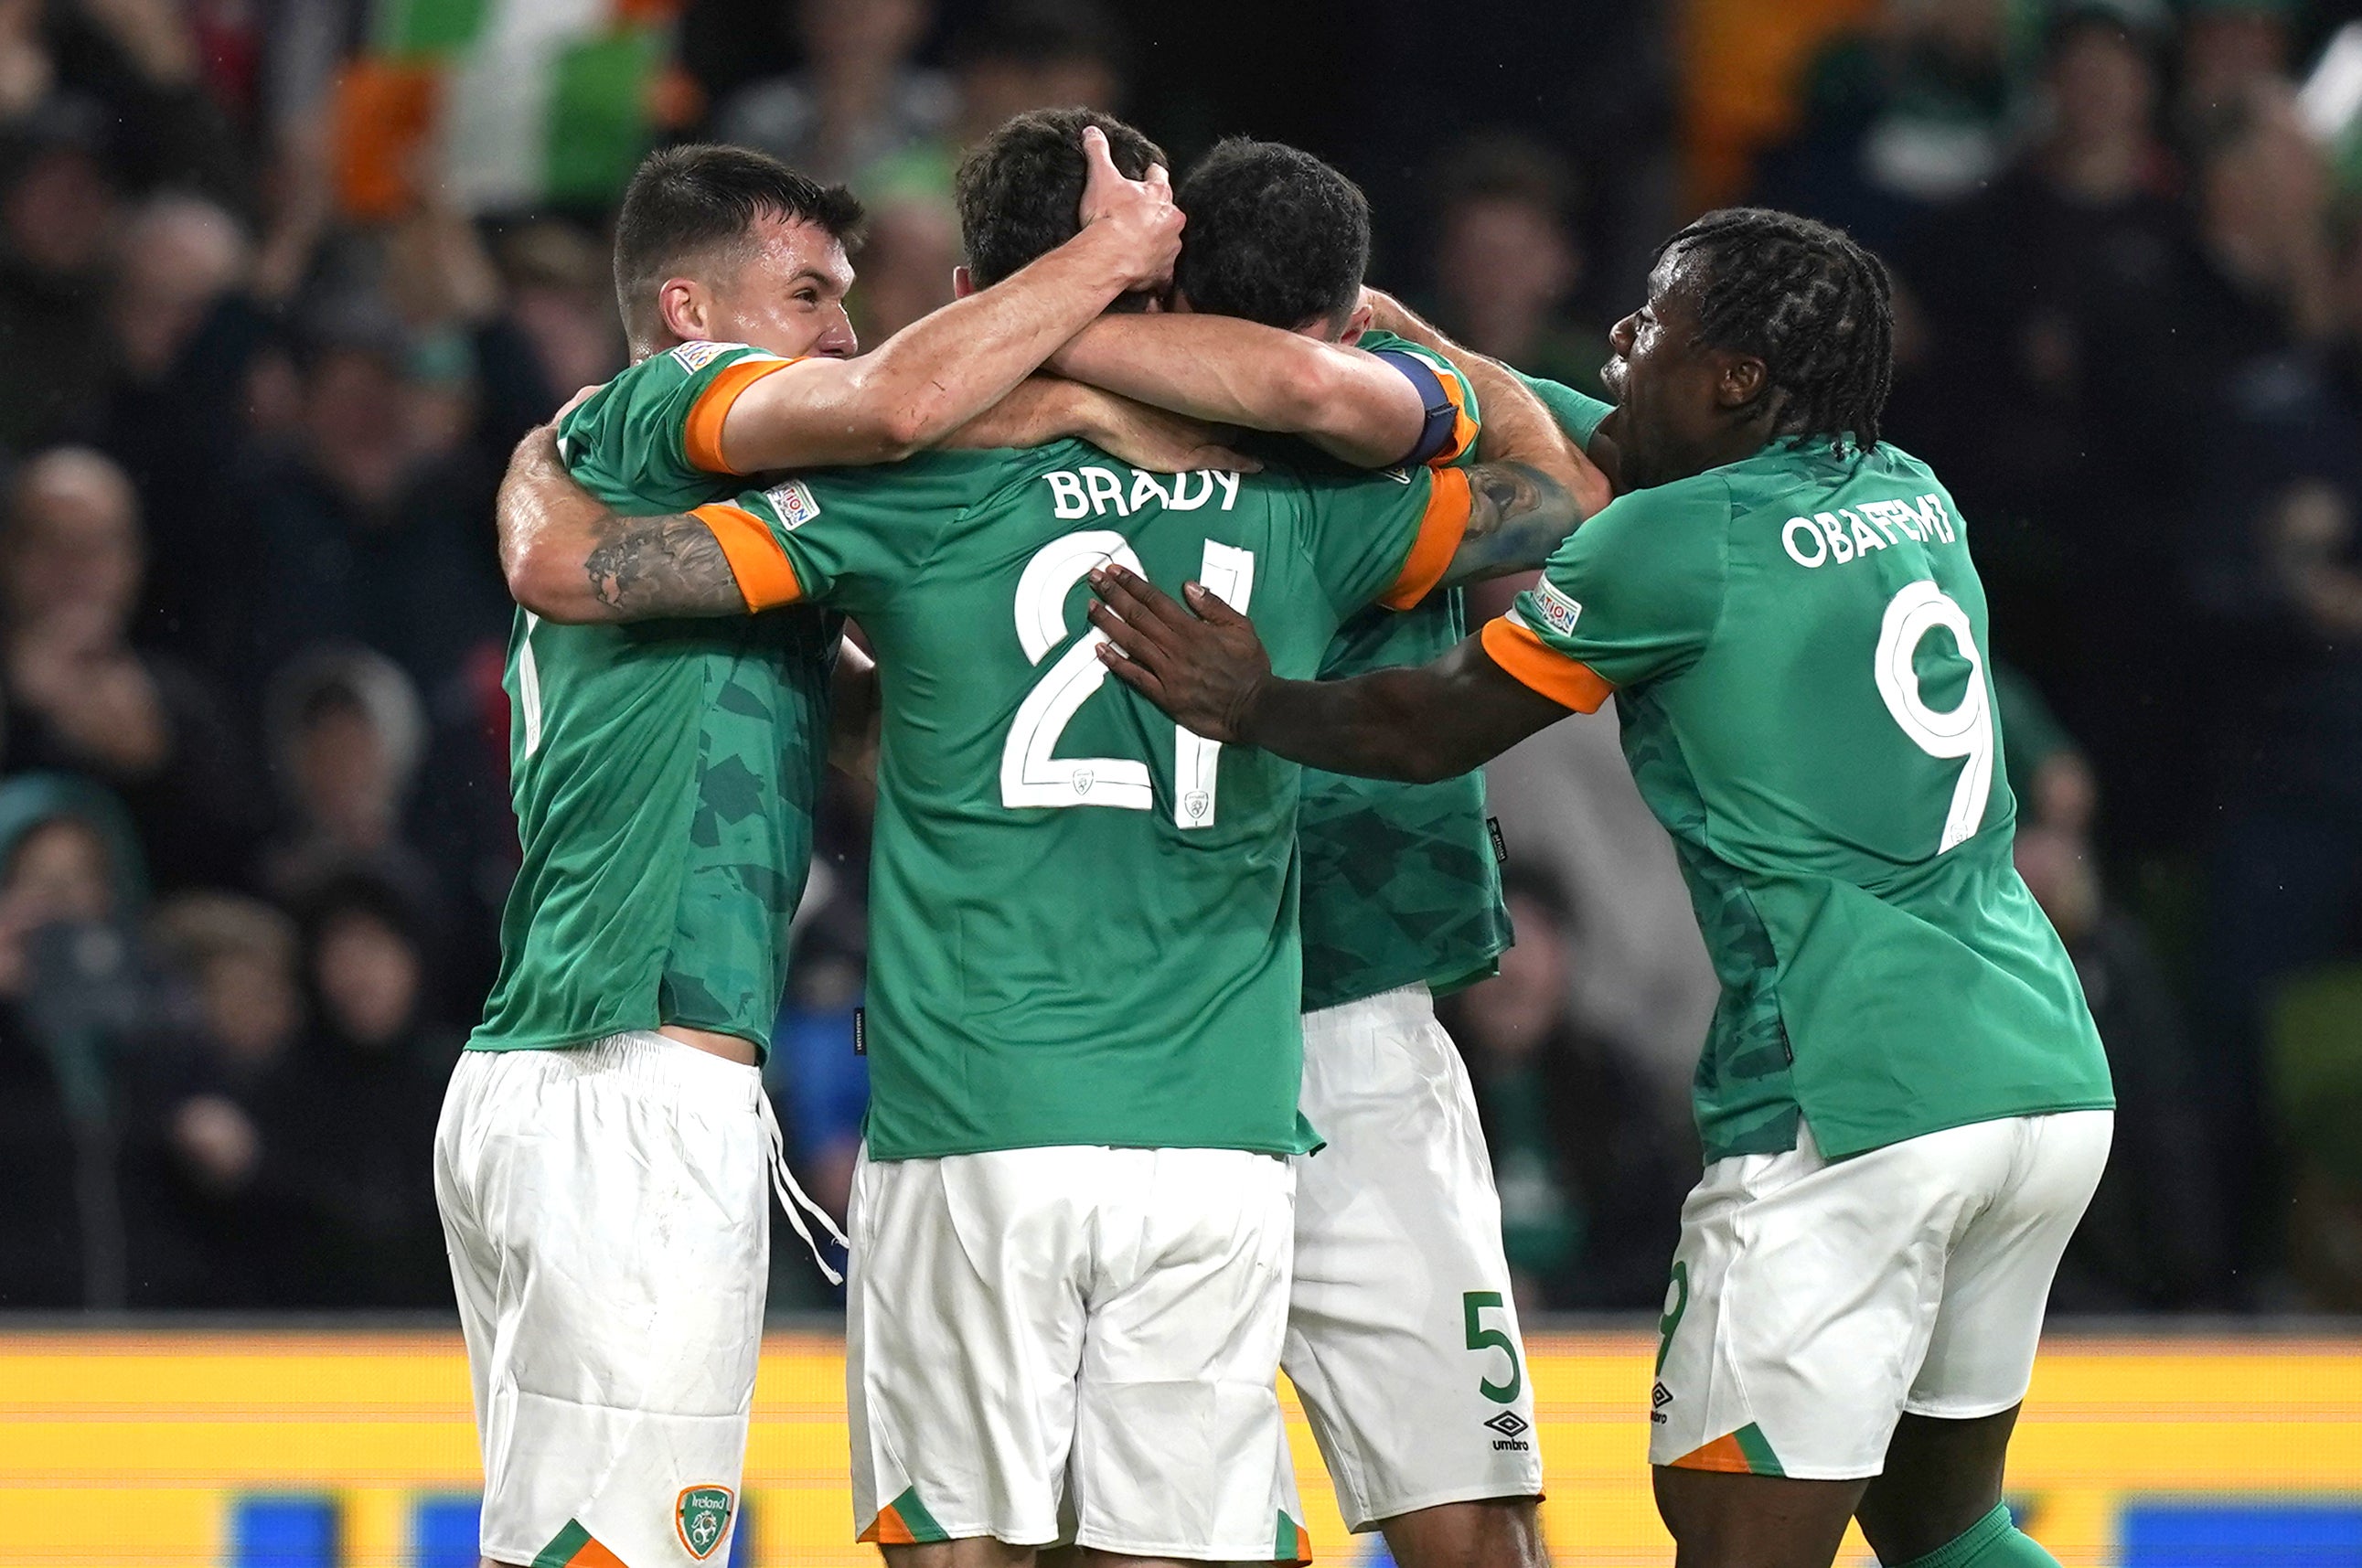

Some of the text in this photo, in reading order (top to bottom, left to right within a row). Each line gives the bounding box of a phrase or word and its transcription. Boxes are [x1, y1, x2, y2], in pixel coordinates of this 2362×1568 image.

[1042, 466, 1241, 520] BRADY
[1780, 493, 1956, 569] OBAFEMI
[1538, 592, 1576, 626] ATION
[1000, 529, 1255, 830] 21
[1875, 580, 1993, 856] 9
[1463, 1291, 1521, 1404] 5
[1492, 1438, 1529, 1452] umbro
[691, 1492, 725, 1509] Ireland
